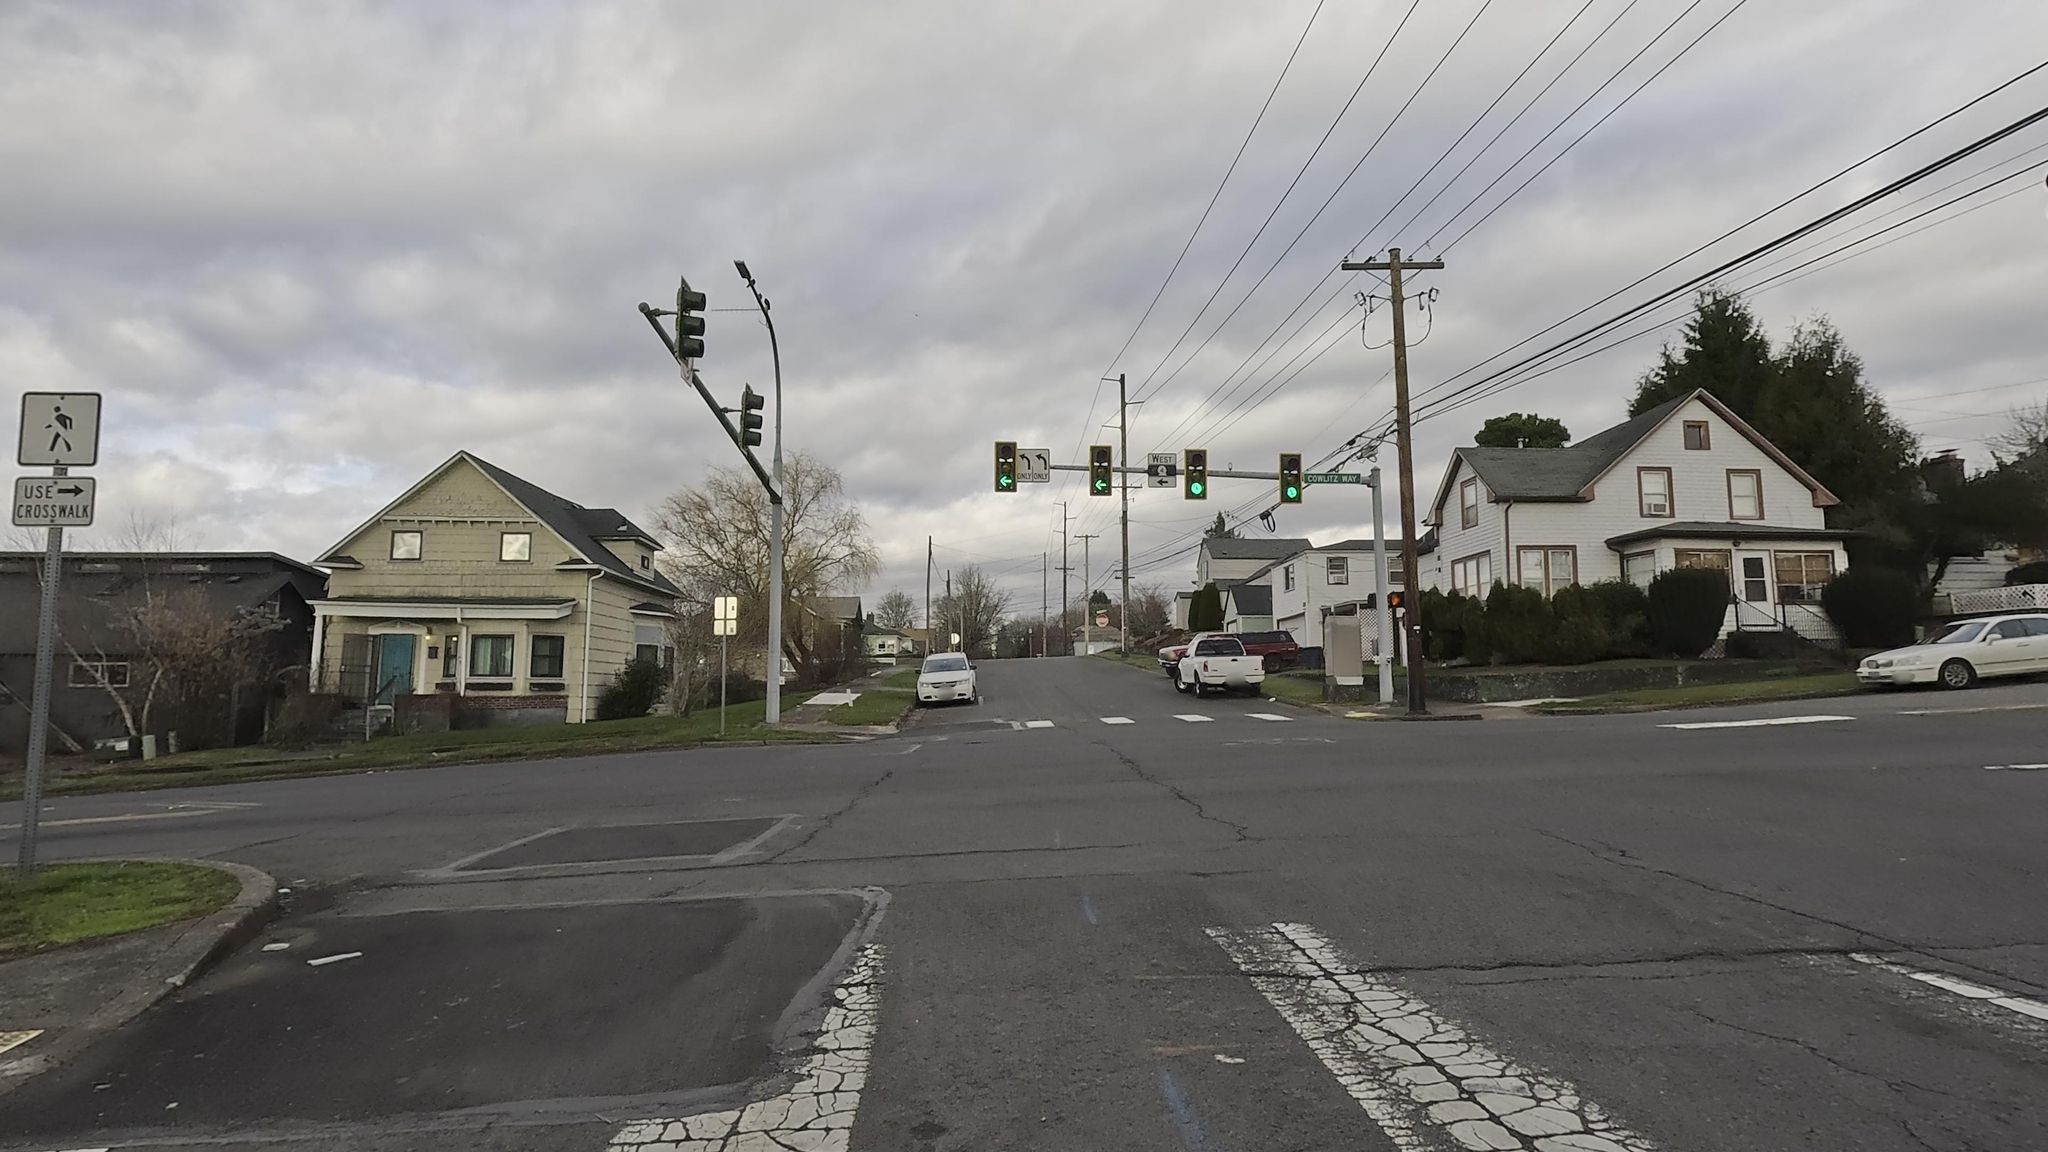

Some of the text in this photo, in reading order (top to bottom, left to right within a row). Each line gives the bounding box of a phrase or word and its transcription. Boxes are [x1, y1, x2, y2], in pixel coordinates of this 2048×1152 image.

[1151, 454, 1172, 463] WEST
[1307, 474, 1357, 483] COWLITZ WAY
[24, 485, 54, 499] USE
[16, 504, 89, 519] CROSSWALK
